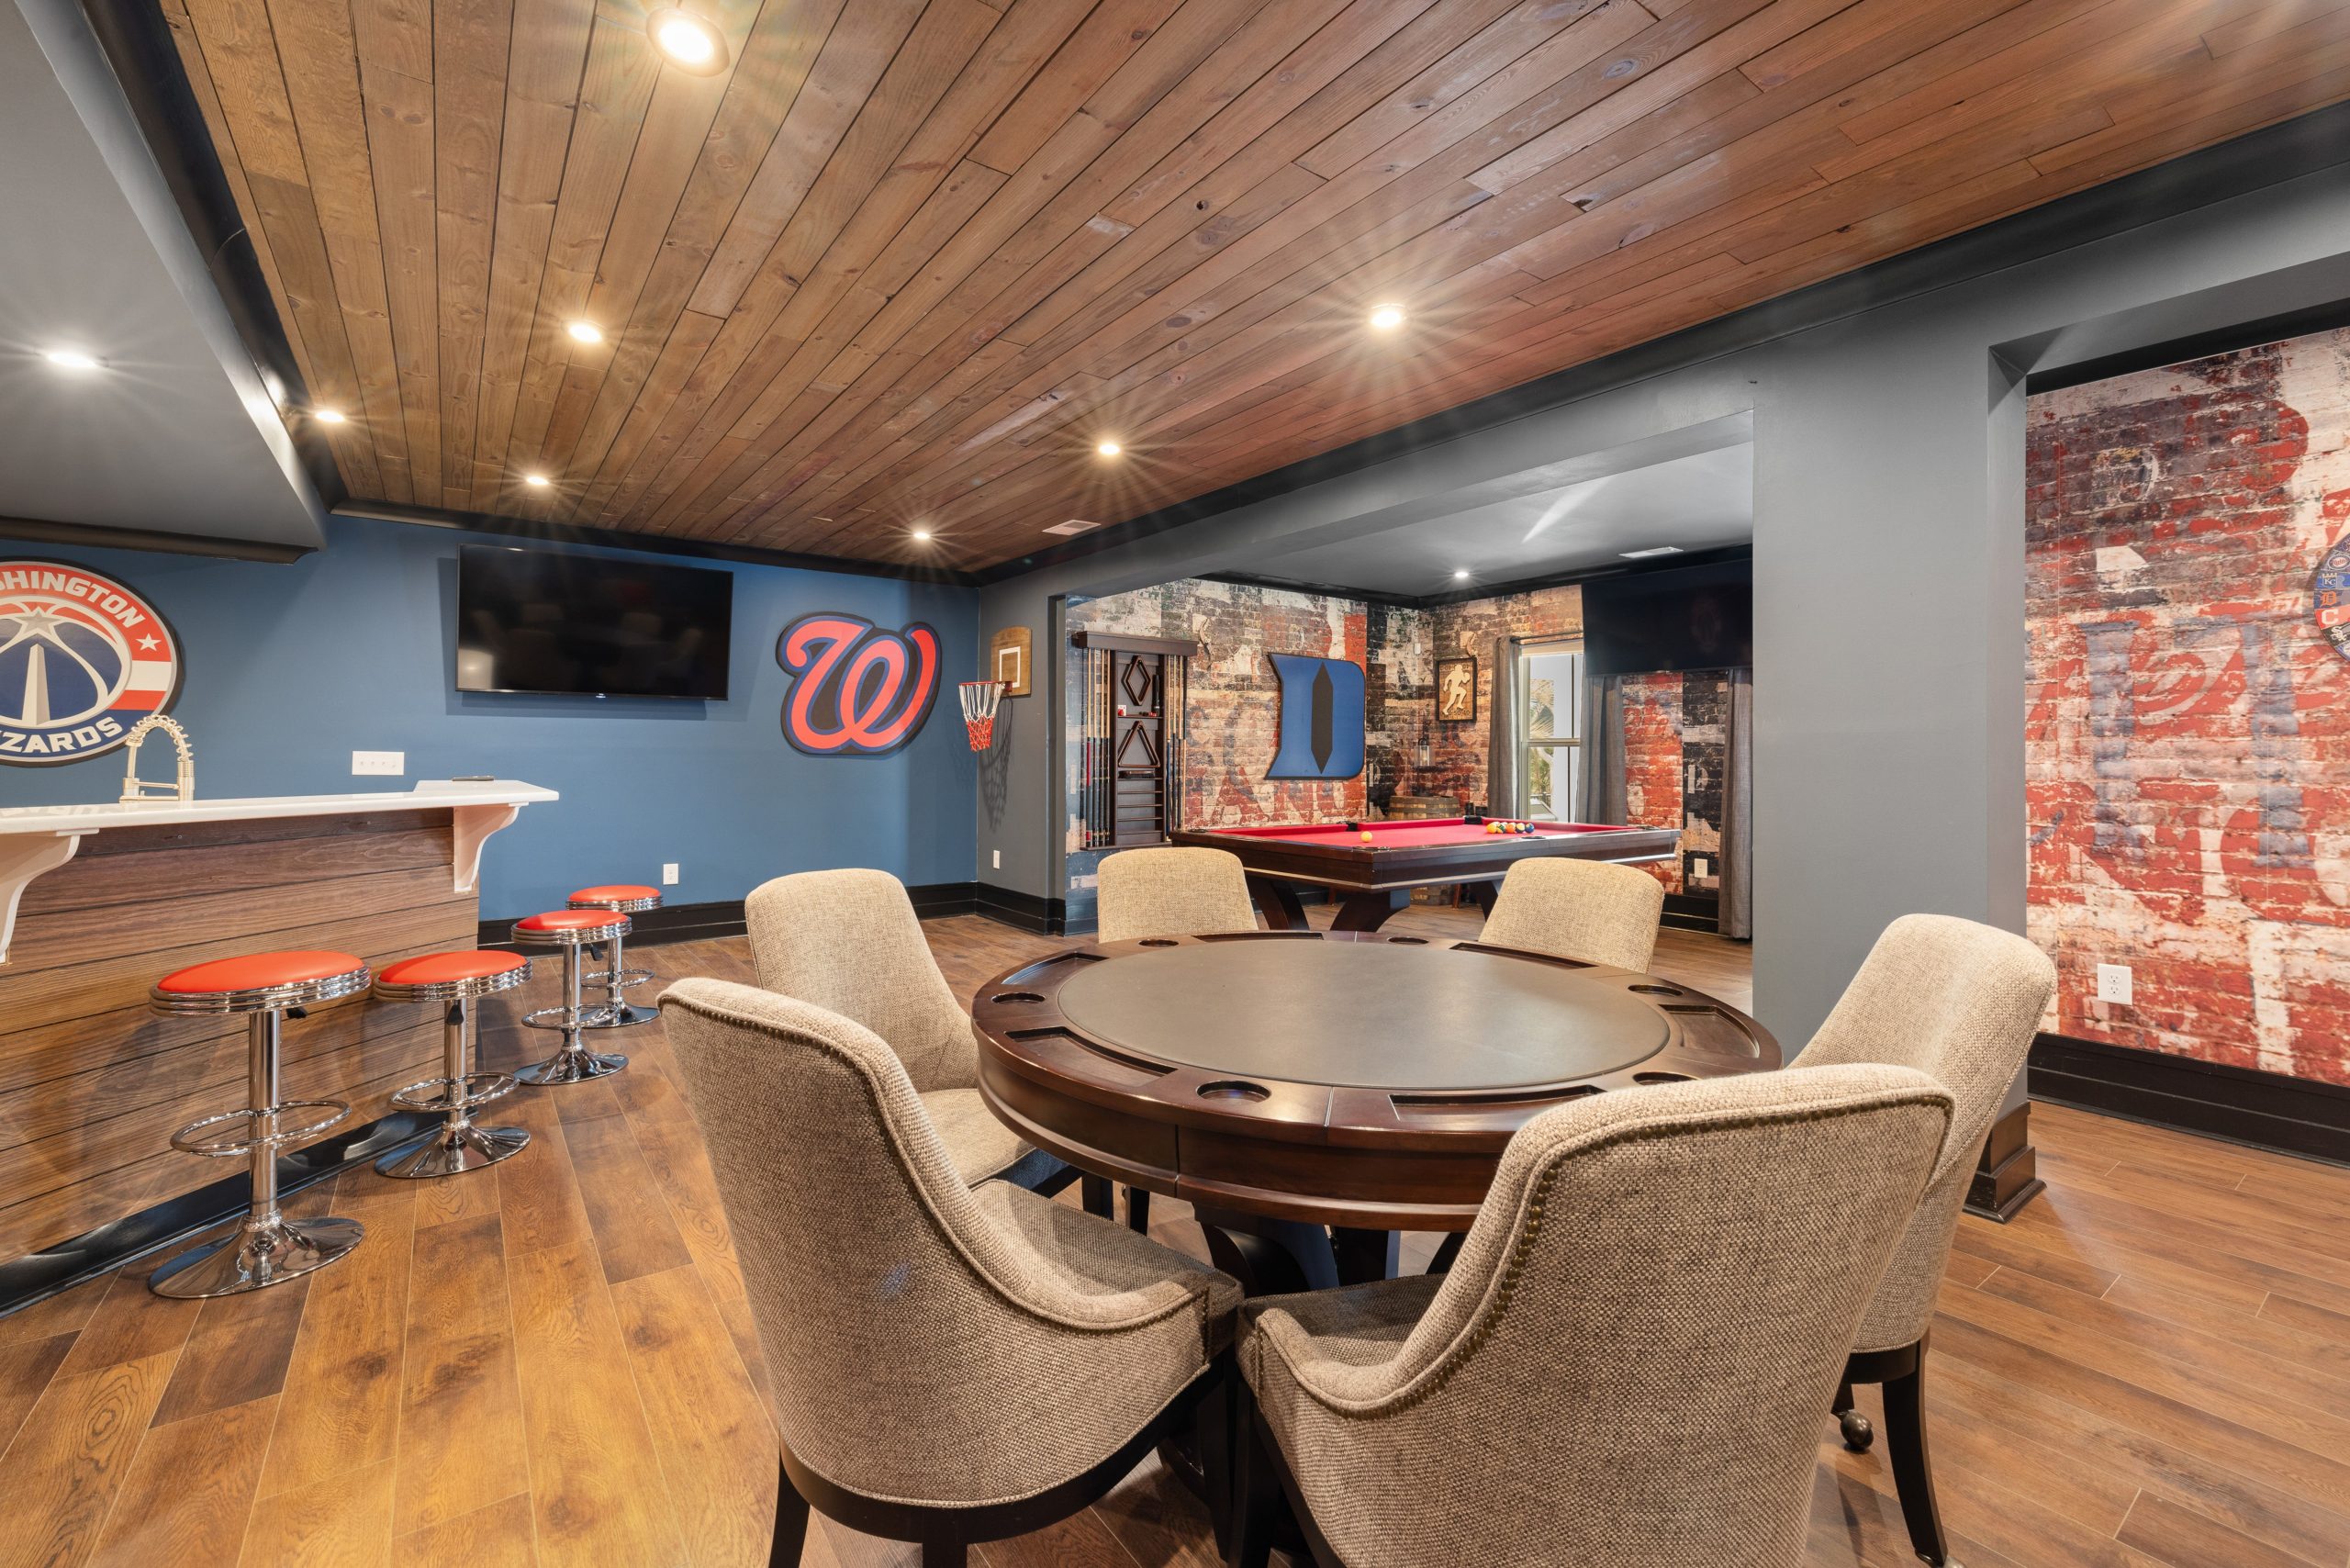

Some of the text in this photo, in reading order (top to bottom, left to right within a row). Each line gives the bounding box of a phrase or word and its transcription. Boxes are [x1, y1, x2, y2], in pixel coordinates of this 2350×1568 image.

[0, 570, 145, 628] HINGTON
[2322, 610, 2338, 624] C
[784, 618, 938, 751] W
[0, 716, 123, 753] ZARDS
[1264, 653, 1366, 780] D
